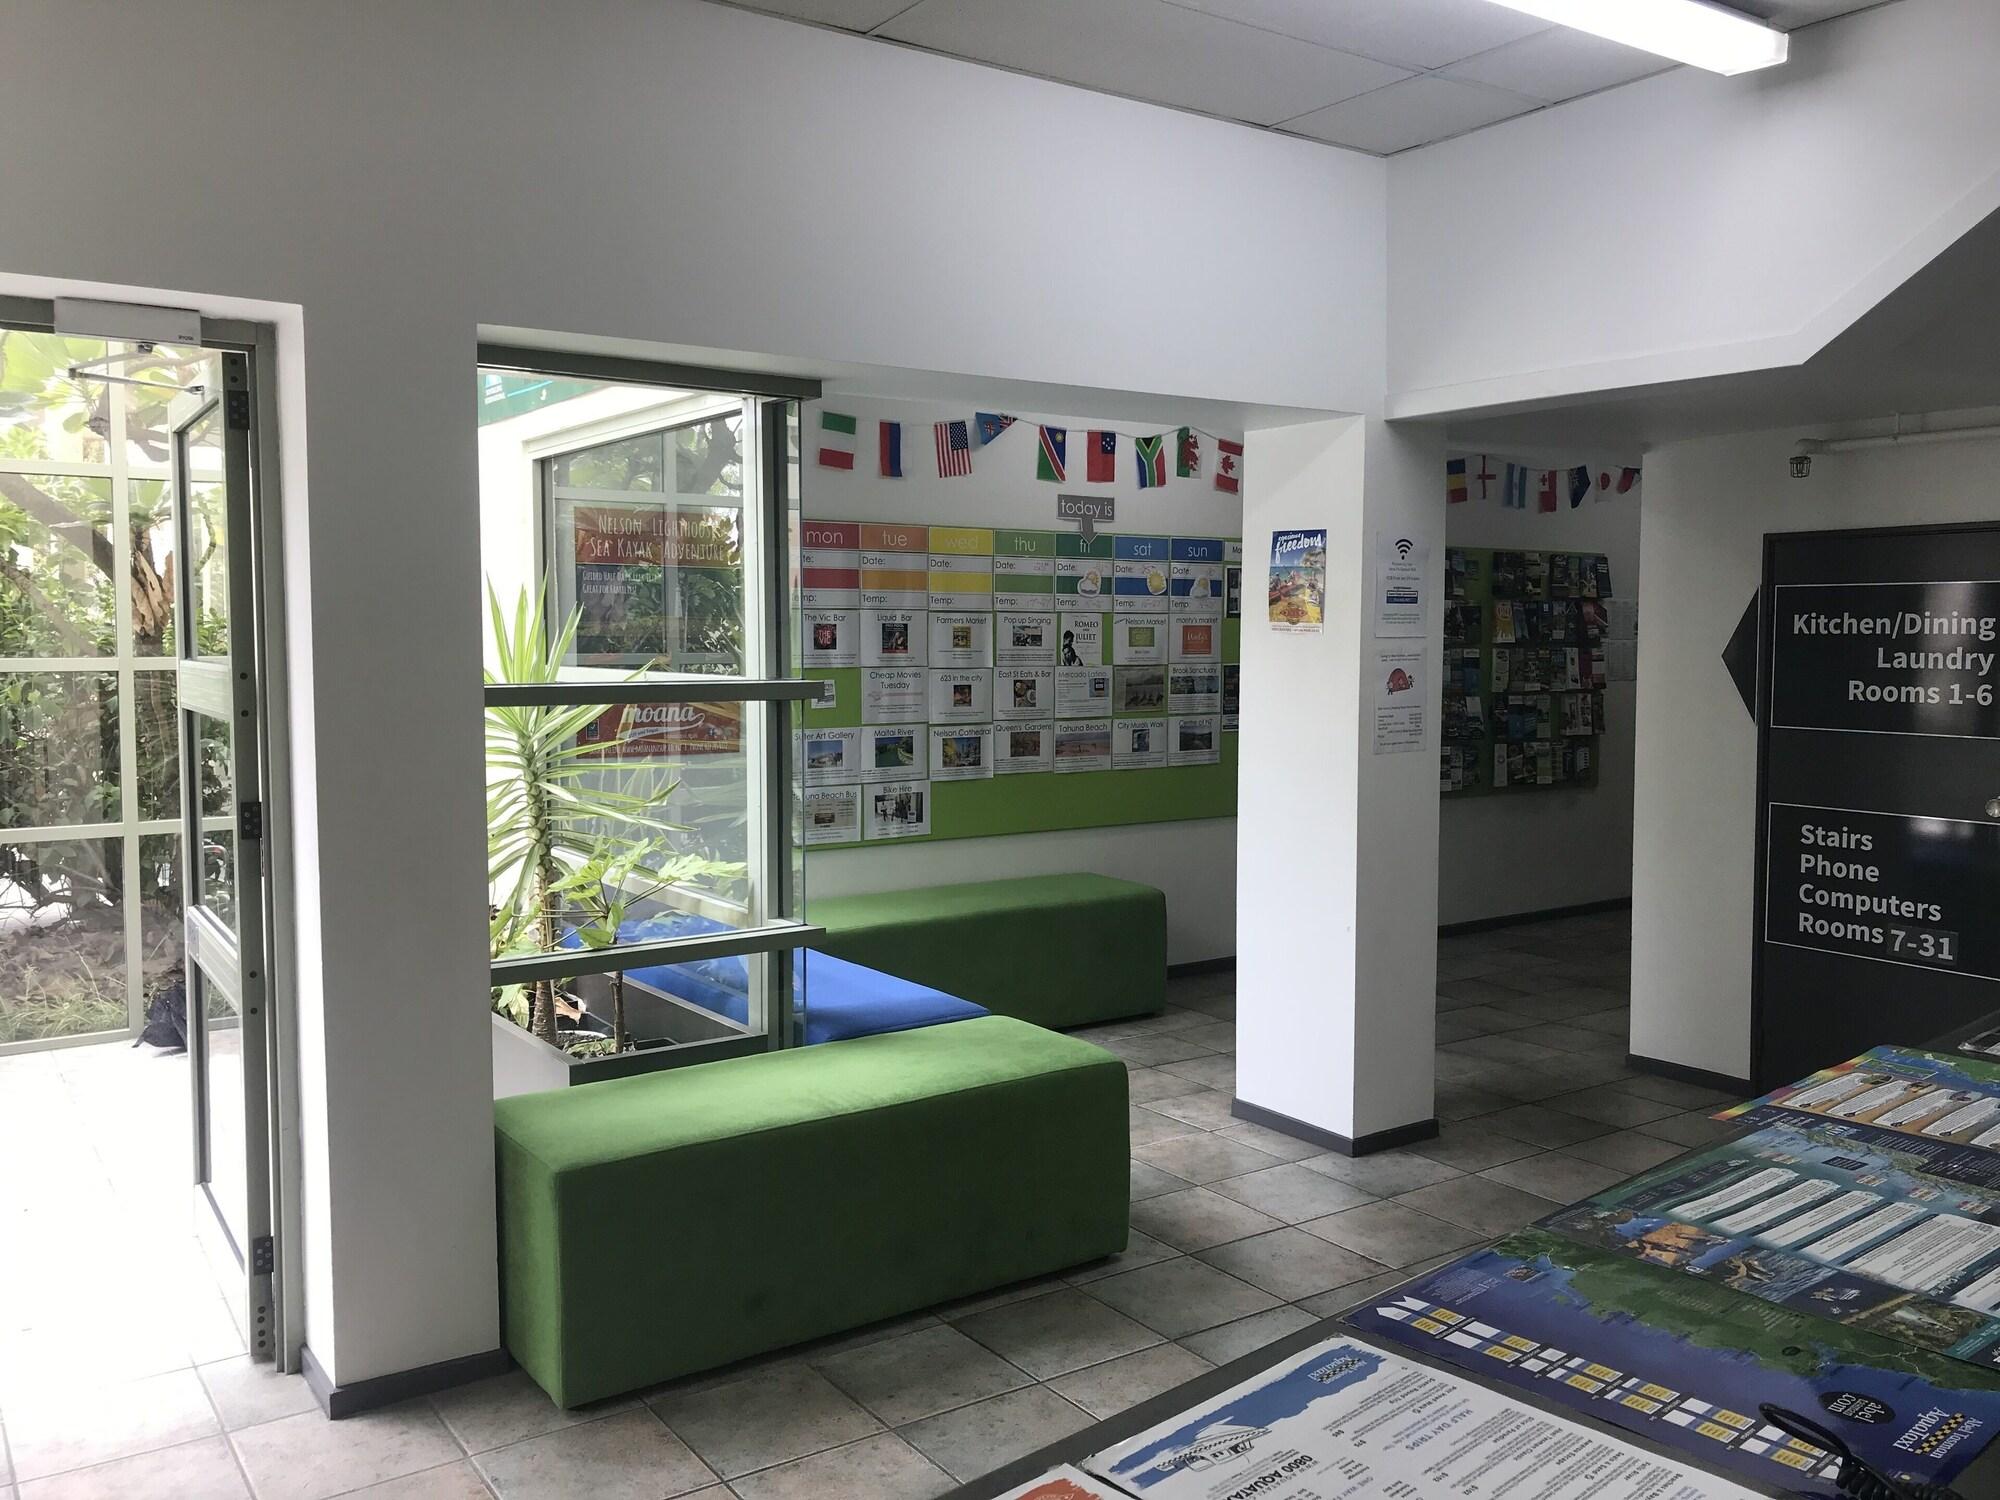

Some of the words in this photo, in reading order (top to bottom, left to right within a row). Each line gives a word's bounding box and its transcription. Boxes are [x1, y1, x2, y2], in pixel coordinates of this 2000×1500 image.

[1061, 500, 1101, 517] today
[1104, 501, 1113, 516] is
[598, 515, 642, 535] NELSON
[805, 530, 844, 544] mon
[882, 530, 908, 546] tue
[944, 535, 978, 550] wed
[590, 537, 611, 557] SEA
[617, 538, 653, 559] KAYAK
[1014, 537, 1036, 551] thu
[1133, 543, 1152, 556] sat
[1275, 533, 1322, 564] freedom
[1187, 546, 1208, 557] sun
[862, 556, 886, 565] Date:
[930, 559, 952, 568] Date:
[995, 561, 1016, 569] Date:
[1115, 565, 1134, 573] Date:
[863, 594, 887, 604] Temp:
[930, 596, 954, 605] Temp:
[995, 597, 1017, 606] Temp:
[1057, 598, 1079, 607] Temp:
[1115, 600, 1136, 608] Temp:
[877, 614, 897, 622] Liquid
[936, 616, 964, 624] Farmers
[965, 616, 987, 625] Market
[1003, 616, 1017, 625] Pop
[1028, 616, 1052, 625] Singing
[1074, 620, 1099, 628] ROMEO
[1793, 611, 1996, 641] Kitchen/Dining
[818, 636, 832, 645] VIC
[1076, 633, 1097, 641] JULIET
[1877, 647, 1995, 676] Laundry
[869, 671, 896, 680] Cheap
[896, 671, 922, 679] Movies
[971, 675, 983, 683] city
[998, 670, 1011, 678] East
[1012, 670, 1019, 678] St
[1020, 670, 1033, 678] Eats
[881, 682, 911, 690] Tuesday
[1849, 680, 1941, 705] Rooms
[1949, 683, 1993, 706] 1-6
[623, 704, 695, 723] moana
[897, 728, 914, 736] River
[958, 728, 992, 737] Cathedral
[1059, 724, 1085, 733] Tahuna
[1085, 723, 1107, 731] Beach
[816, 732, 826, 740] Art
[827, 731, 855, 740] Gallery
[821, 791, 845, 800] Beach
[1800, 824, 1873, 851] Stairs
[1800, 854, 1880, 882] Phone
[1799, 883, 1942, 922] Computers
[1799, 912, 1884, 944] Rooms
[1890, 929, 1954, 961] 7-31
[1447, 1409, 1474, 1424] HALF
[1854, 1401, 1886, 1424] abel
[1428, 1422, 1452, 1435] DAY
[1892, 1406, 1950, 1452] AquaTaxi
[1960, 1417, 1984, 1436] Abel
[1402, 1433, 1433, 1450] TRIPS
[1929, 1431, 1970, 1459] Tasman
[1278, 1454, 1314, 1472] 0800
